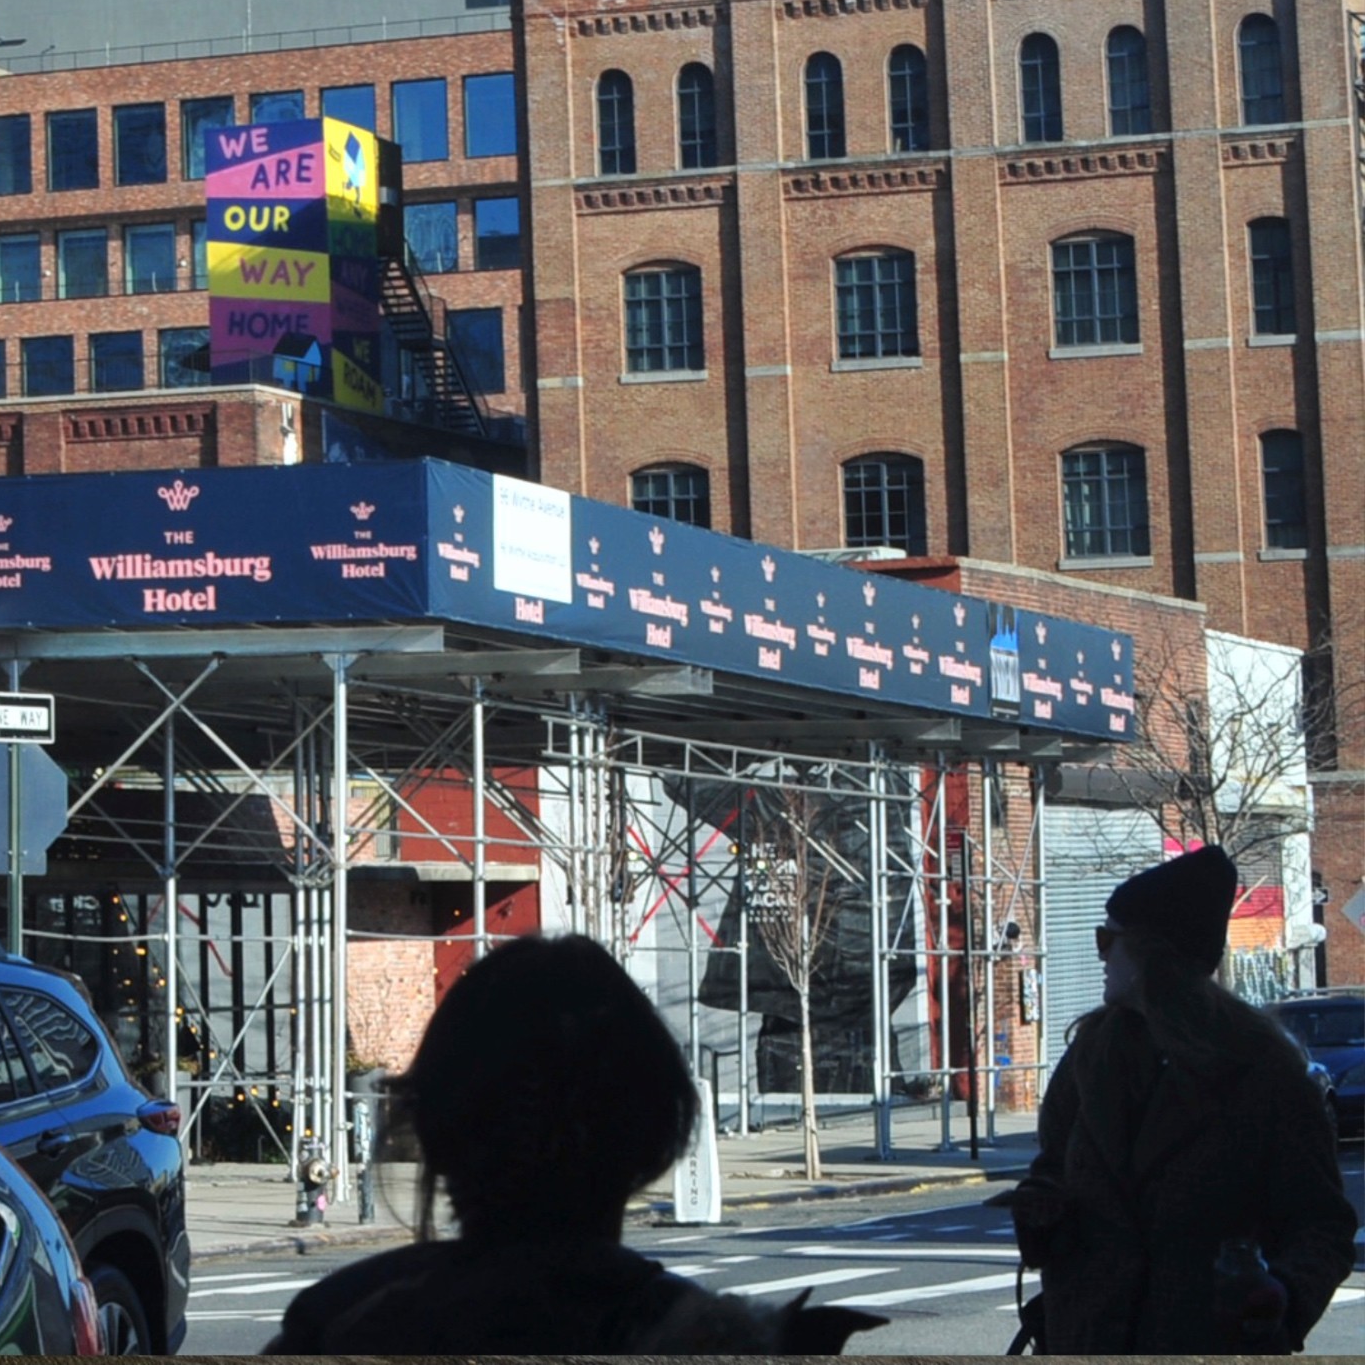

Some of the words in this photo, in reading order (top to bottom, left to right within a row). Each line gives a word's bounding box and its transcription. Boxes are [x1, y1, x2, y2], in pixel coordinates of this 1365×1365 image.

[219, 128, 268, 158] WE
[251, 153, 314, 190] ARE
[224, 205, 290, 233] OUR
[239, 259, 315, 287] WAY
[228, 310, 309, 339] HOME
[164, 531, 194, 544] THE
[310, 542, 417, 560] Williamsburg
[88, 551, 272, 582] Williamsburg
[342, 562, 385, 578] Hotel
[143, 585, 216, 612] Hotel
[20, 711, 43, 726] WAY
